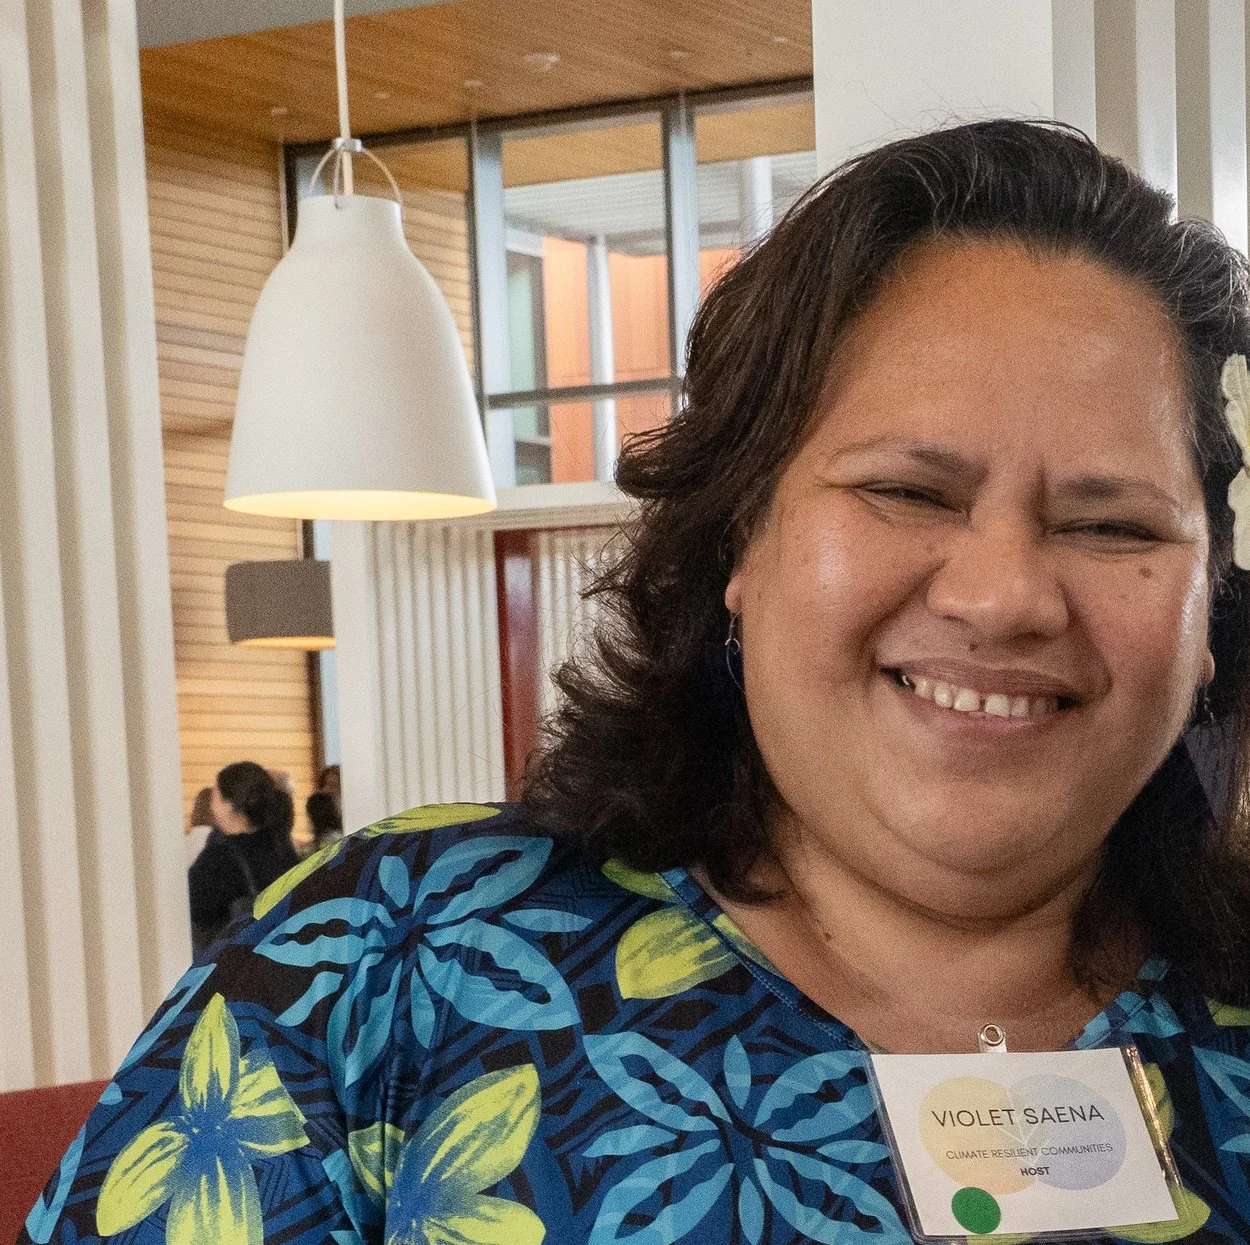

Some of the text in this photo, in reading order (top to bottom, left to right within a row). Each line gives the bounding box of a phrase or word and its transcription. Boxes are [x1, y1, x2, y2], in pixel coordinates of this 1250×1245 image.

[931, 1104, 1105, 1127] VIOLET SAENA
[946, 1143, 1113, 1160] CLIMATE RESILIENT COMMUNITIES
[1020, 1166, 1050, 1176] HOST
